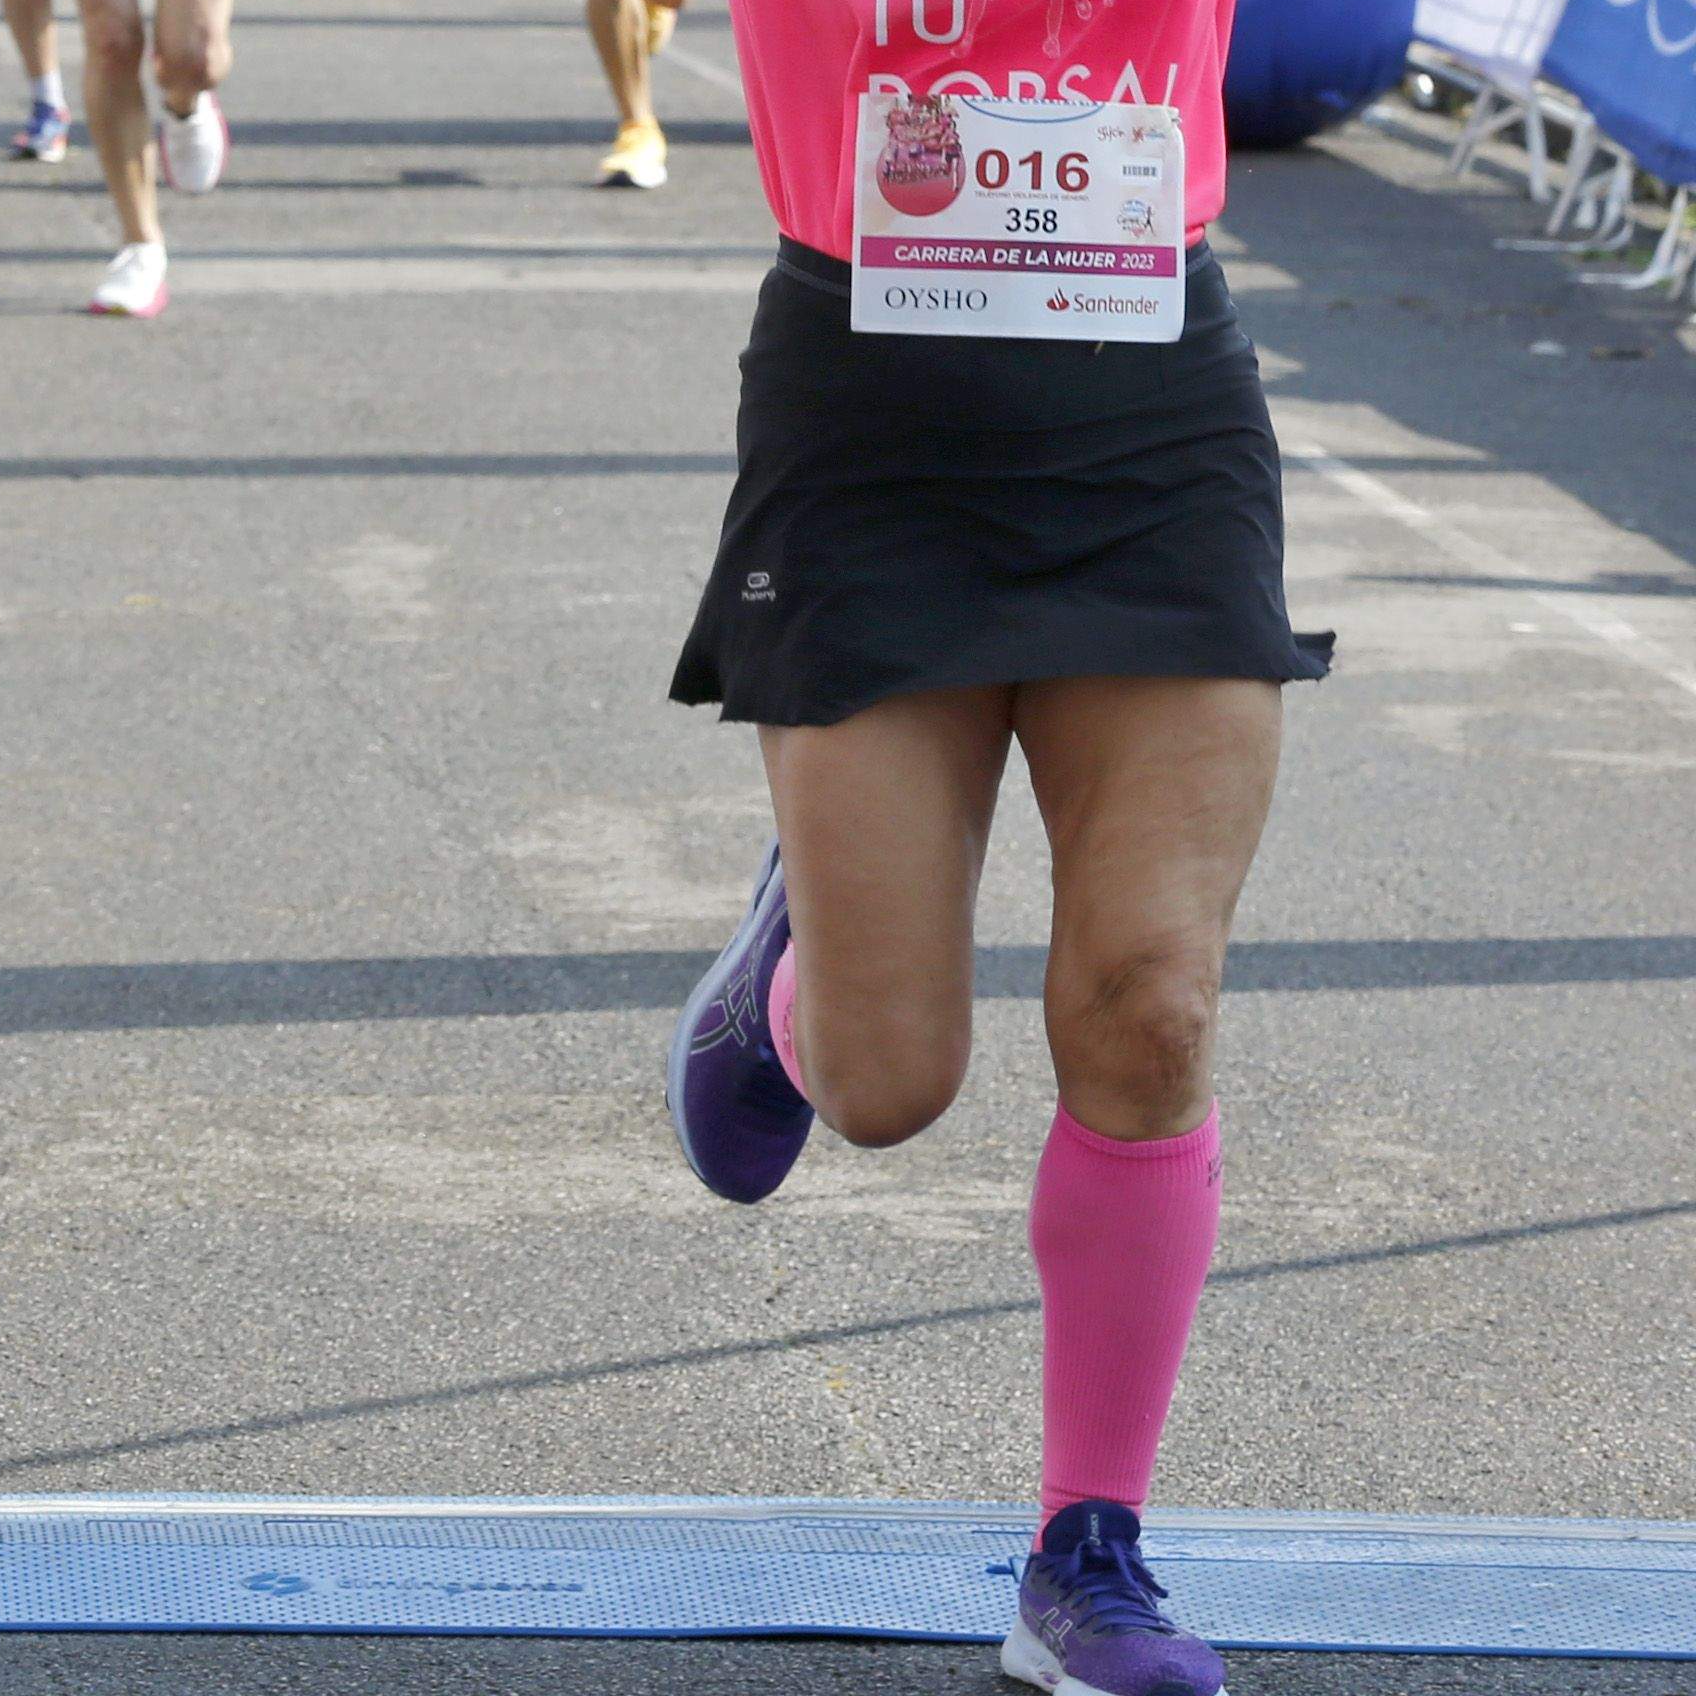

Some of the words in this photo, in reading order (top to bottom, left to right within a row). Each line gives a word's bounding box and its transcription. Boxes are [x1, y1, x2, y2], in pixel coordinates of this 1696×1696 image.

[976, 149, 1090, 192] 016
[1006, 208, 1057, 233] 358
[895, 245, 986, 264] CARRERA
[993, 248, 1020, 265] DE
[1025, 249, 1049, 265] LA
[1055, 251, 1115, 268] MUJER
[885, 286, 987, 312] OYSHO
[1073, 293, 1159, 315] Santander
